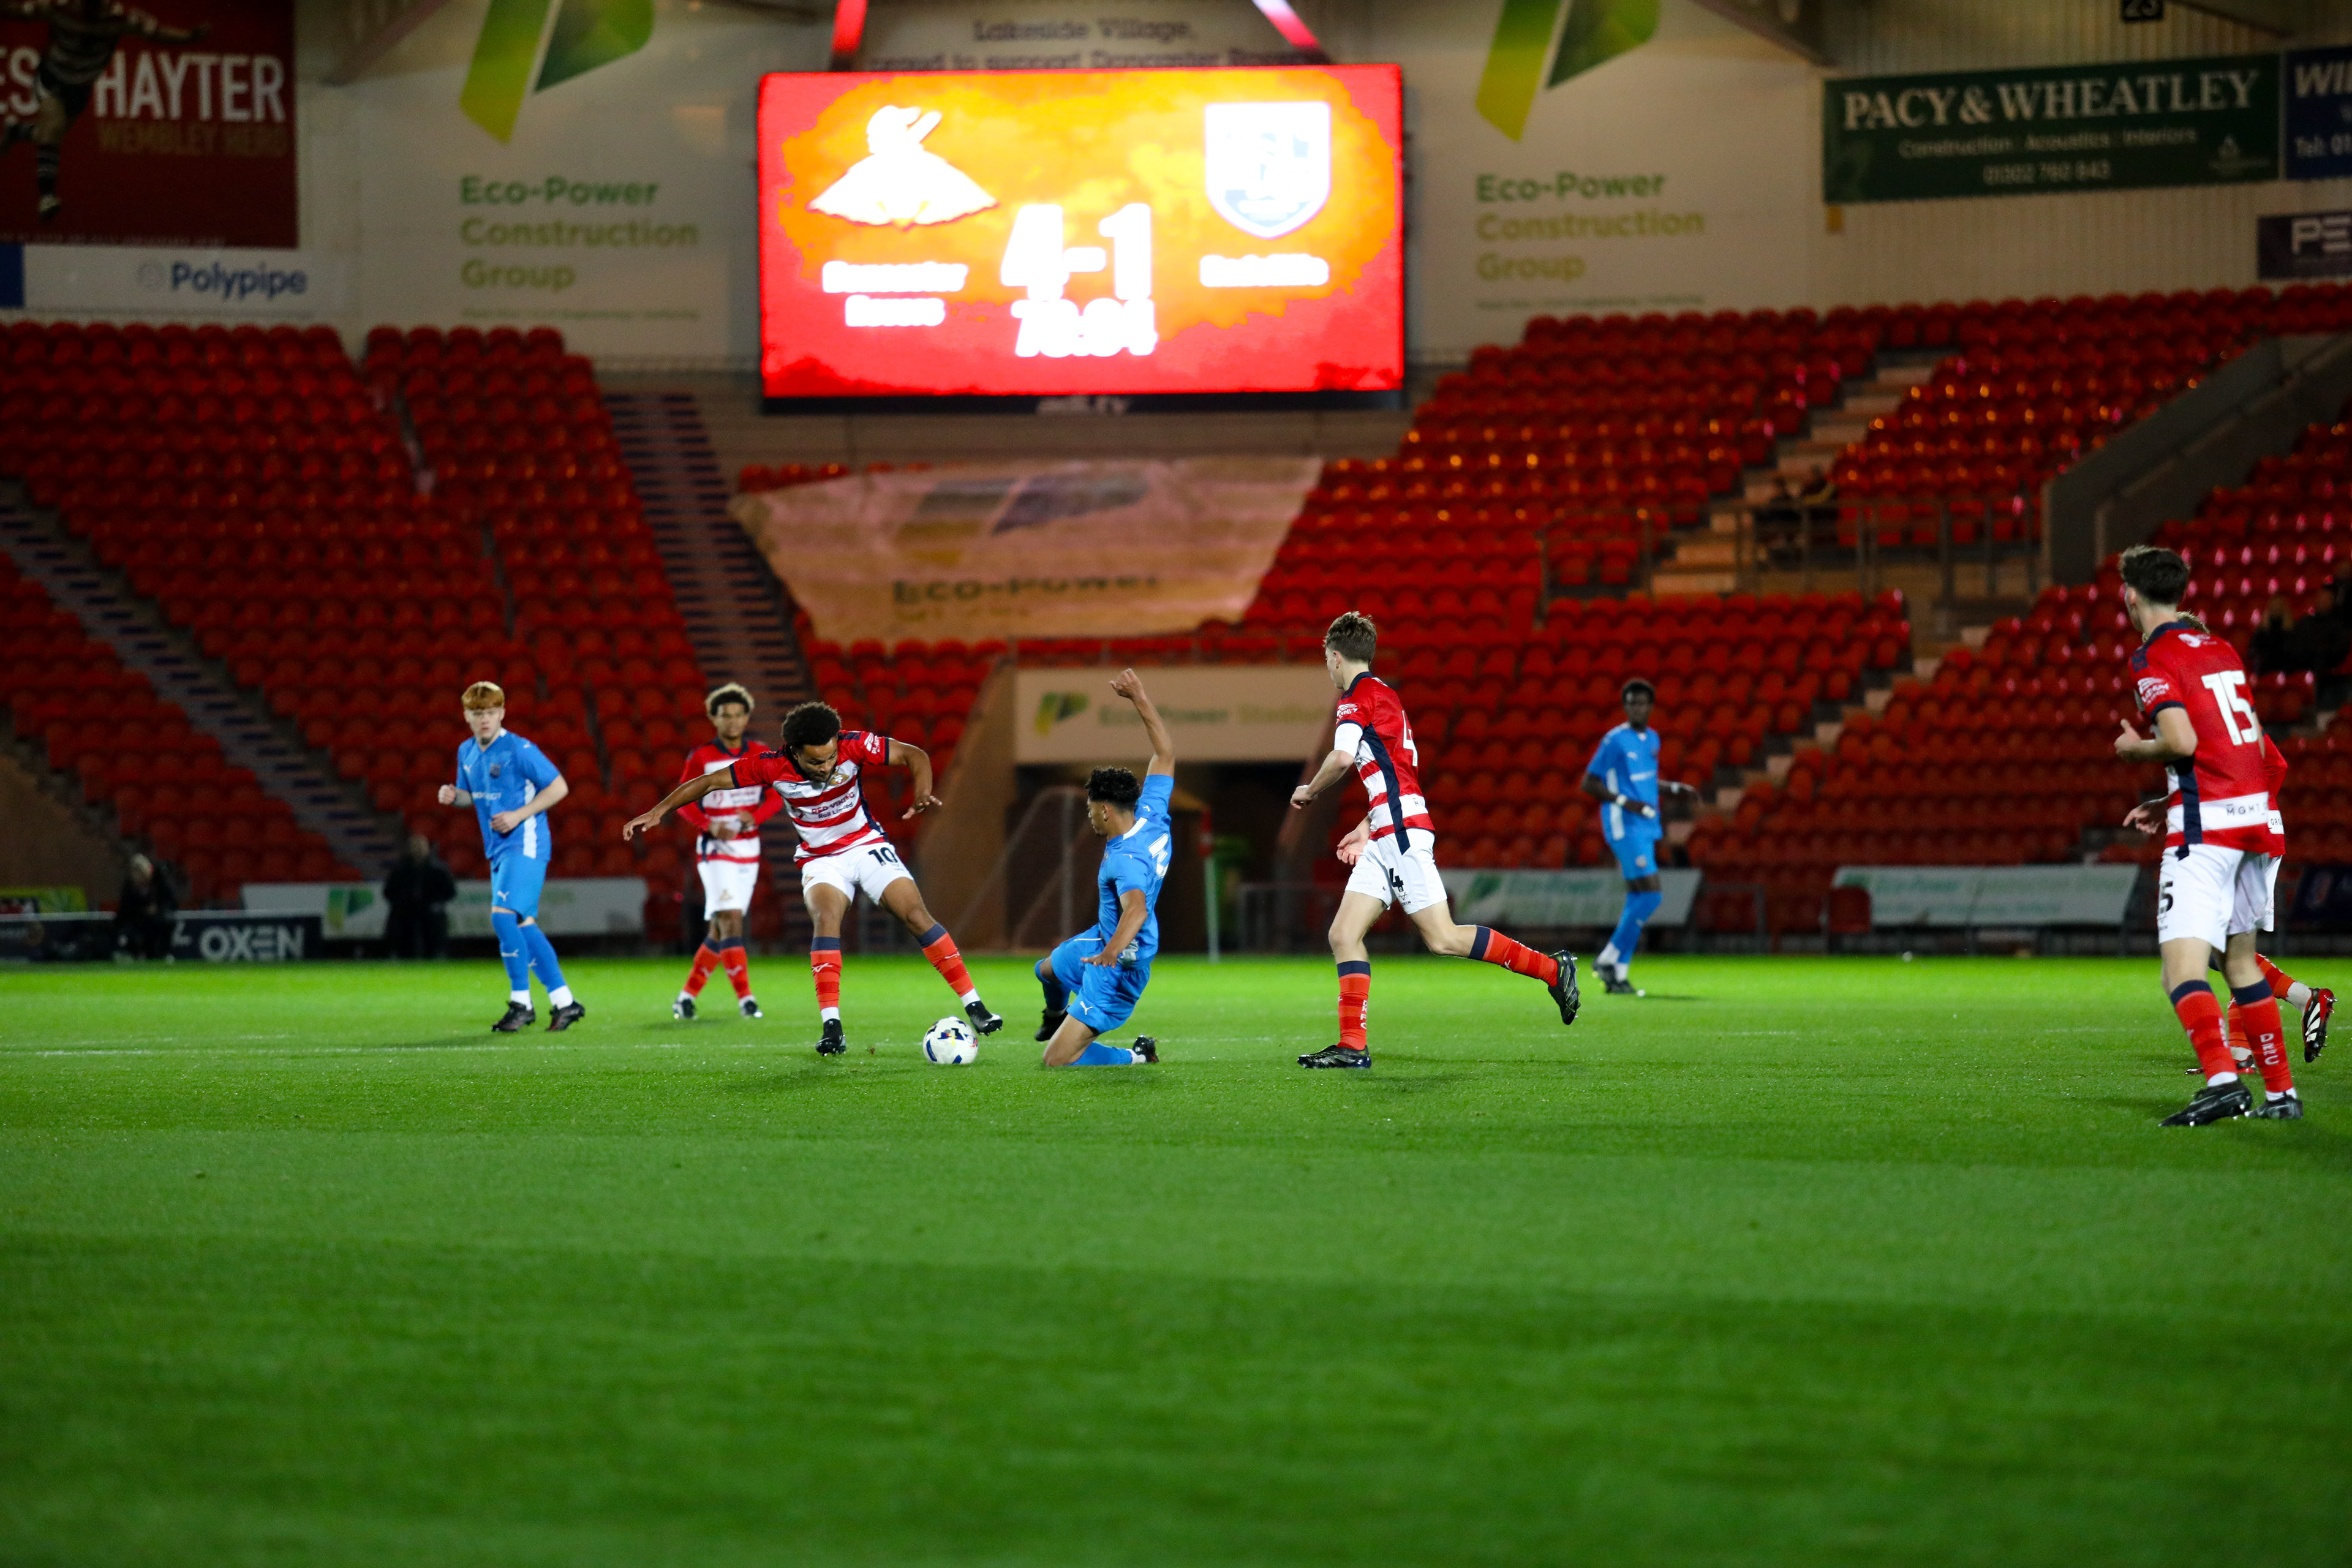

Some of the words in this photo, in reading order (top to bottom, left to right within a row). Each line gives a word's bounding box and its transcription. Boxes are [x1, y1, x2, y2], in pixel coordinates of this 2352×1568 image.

[973, 19, 1088, 42] Lakeside
[94, 49, 285, 123] HAYTER
[1844, 88, 1959, 129] PACY
[1959, 86, 1993, 125] &
[1996, 69, 2260, 121] WHEATLEY
[1898, 136, 2013, 159] Construction
[2025, 130, 2111, 151] Acoustics
[2122, 126, 2198, 146] Interiors
[461, 176, 660, 205] Eco-Power
[1476, 173, 1665, 203] Eco-Power
[460, 216, 701, 248] Construction
[1475, 209, 1706, 242] Construction
[1000, 203, 1152, 300] 4-1
[1475, 251, 1586, 284] Group
[172, 260, 307, 299] Polypipe
[460, 258, 576, 292] Group
[2201, 670, 2259, 745] 15
[1401, 710, 1418, 767] 4
[812, 806, 828, 815] RED
[827, 792, 856, 809] VIKING
[2226, 803, 2260, 816] MGMT
[868, 847, 898, 866] 10
[1389, 867, 1404, 892] 4
[199, 925, 305, 962] OXEN
